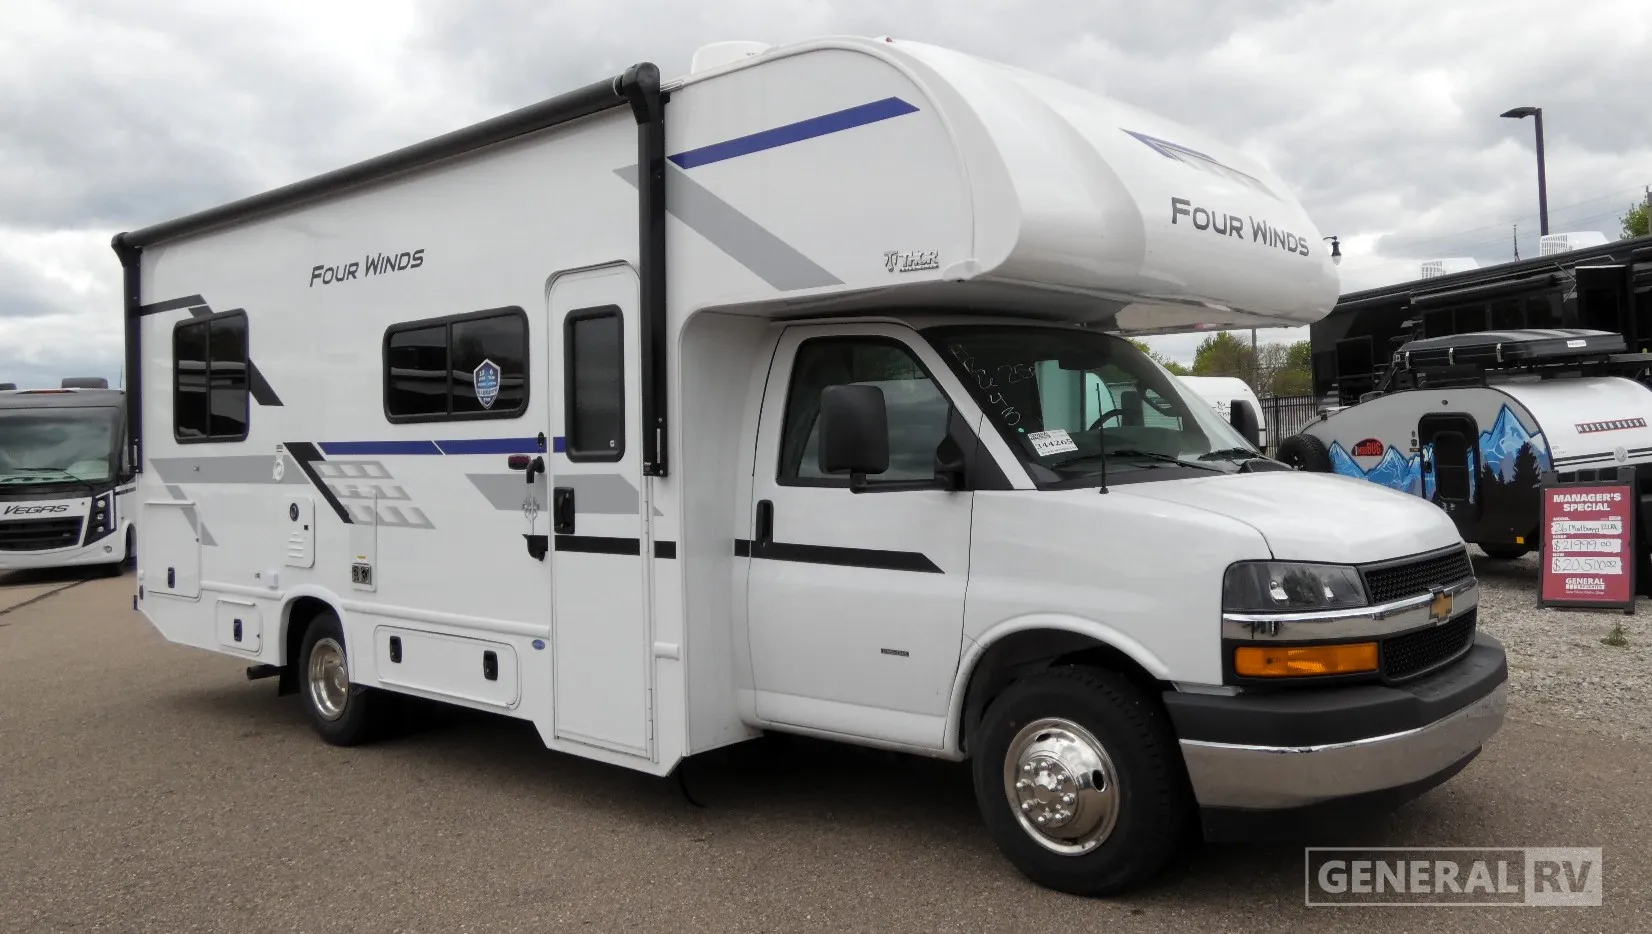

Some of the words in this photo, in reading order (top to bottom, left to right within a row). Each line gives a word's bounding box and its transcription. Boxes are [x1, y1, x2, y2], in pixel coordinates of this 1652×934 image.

[1171, 196, 1244, 239] FOUR
[1249, 215, 1310, 257] WINDS
[899, 250, 939, 268] THOR
[309, 261, 360, 288] FOUR
[364, 248, 425, 277] WINDS
[1035, 438, 1073, 450] 344265
[1553, 493, 1622, 503] MANAGER'S
[3, 504, 70, 515] VEGAS
[1563, 503, 1611, 512] SPECIAL
[1565, 577, 1605, 585] GENERAL
